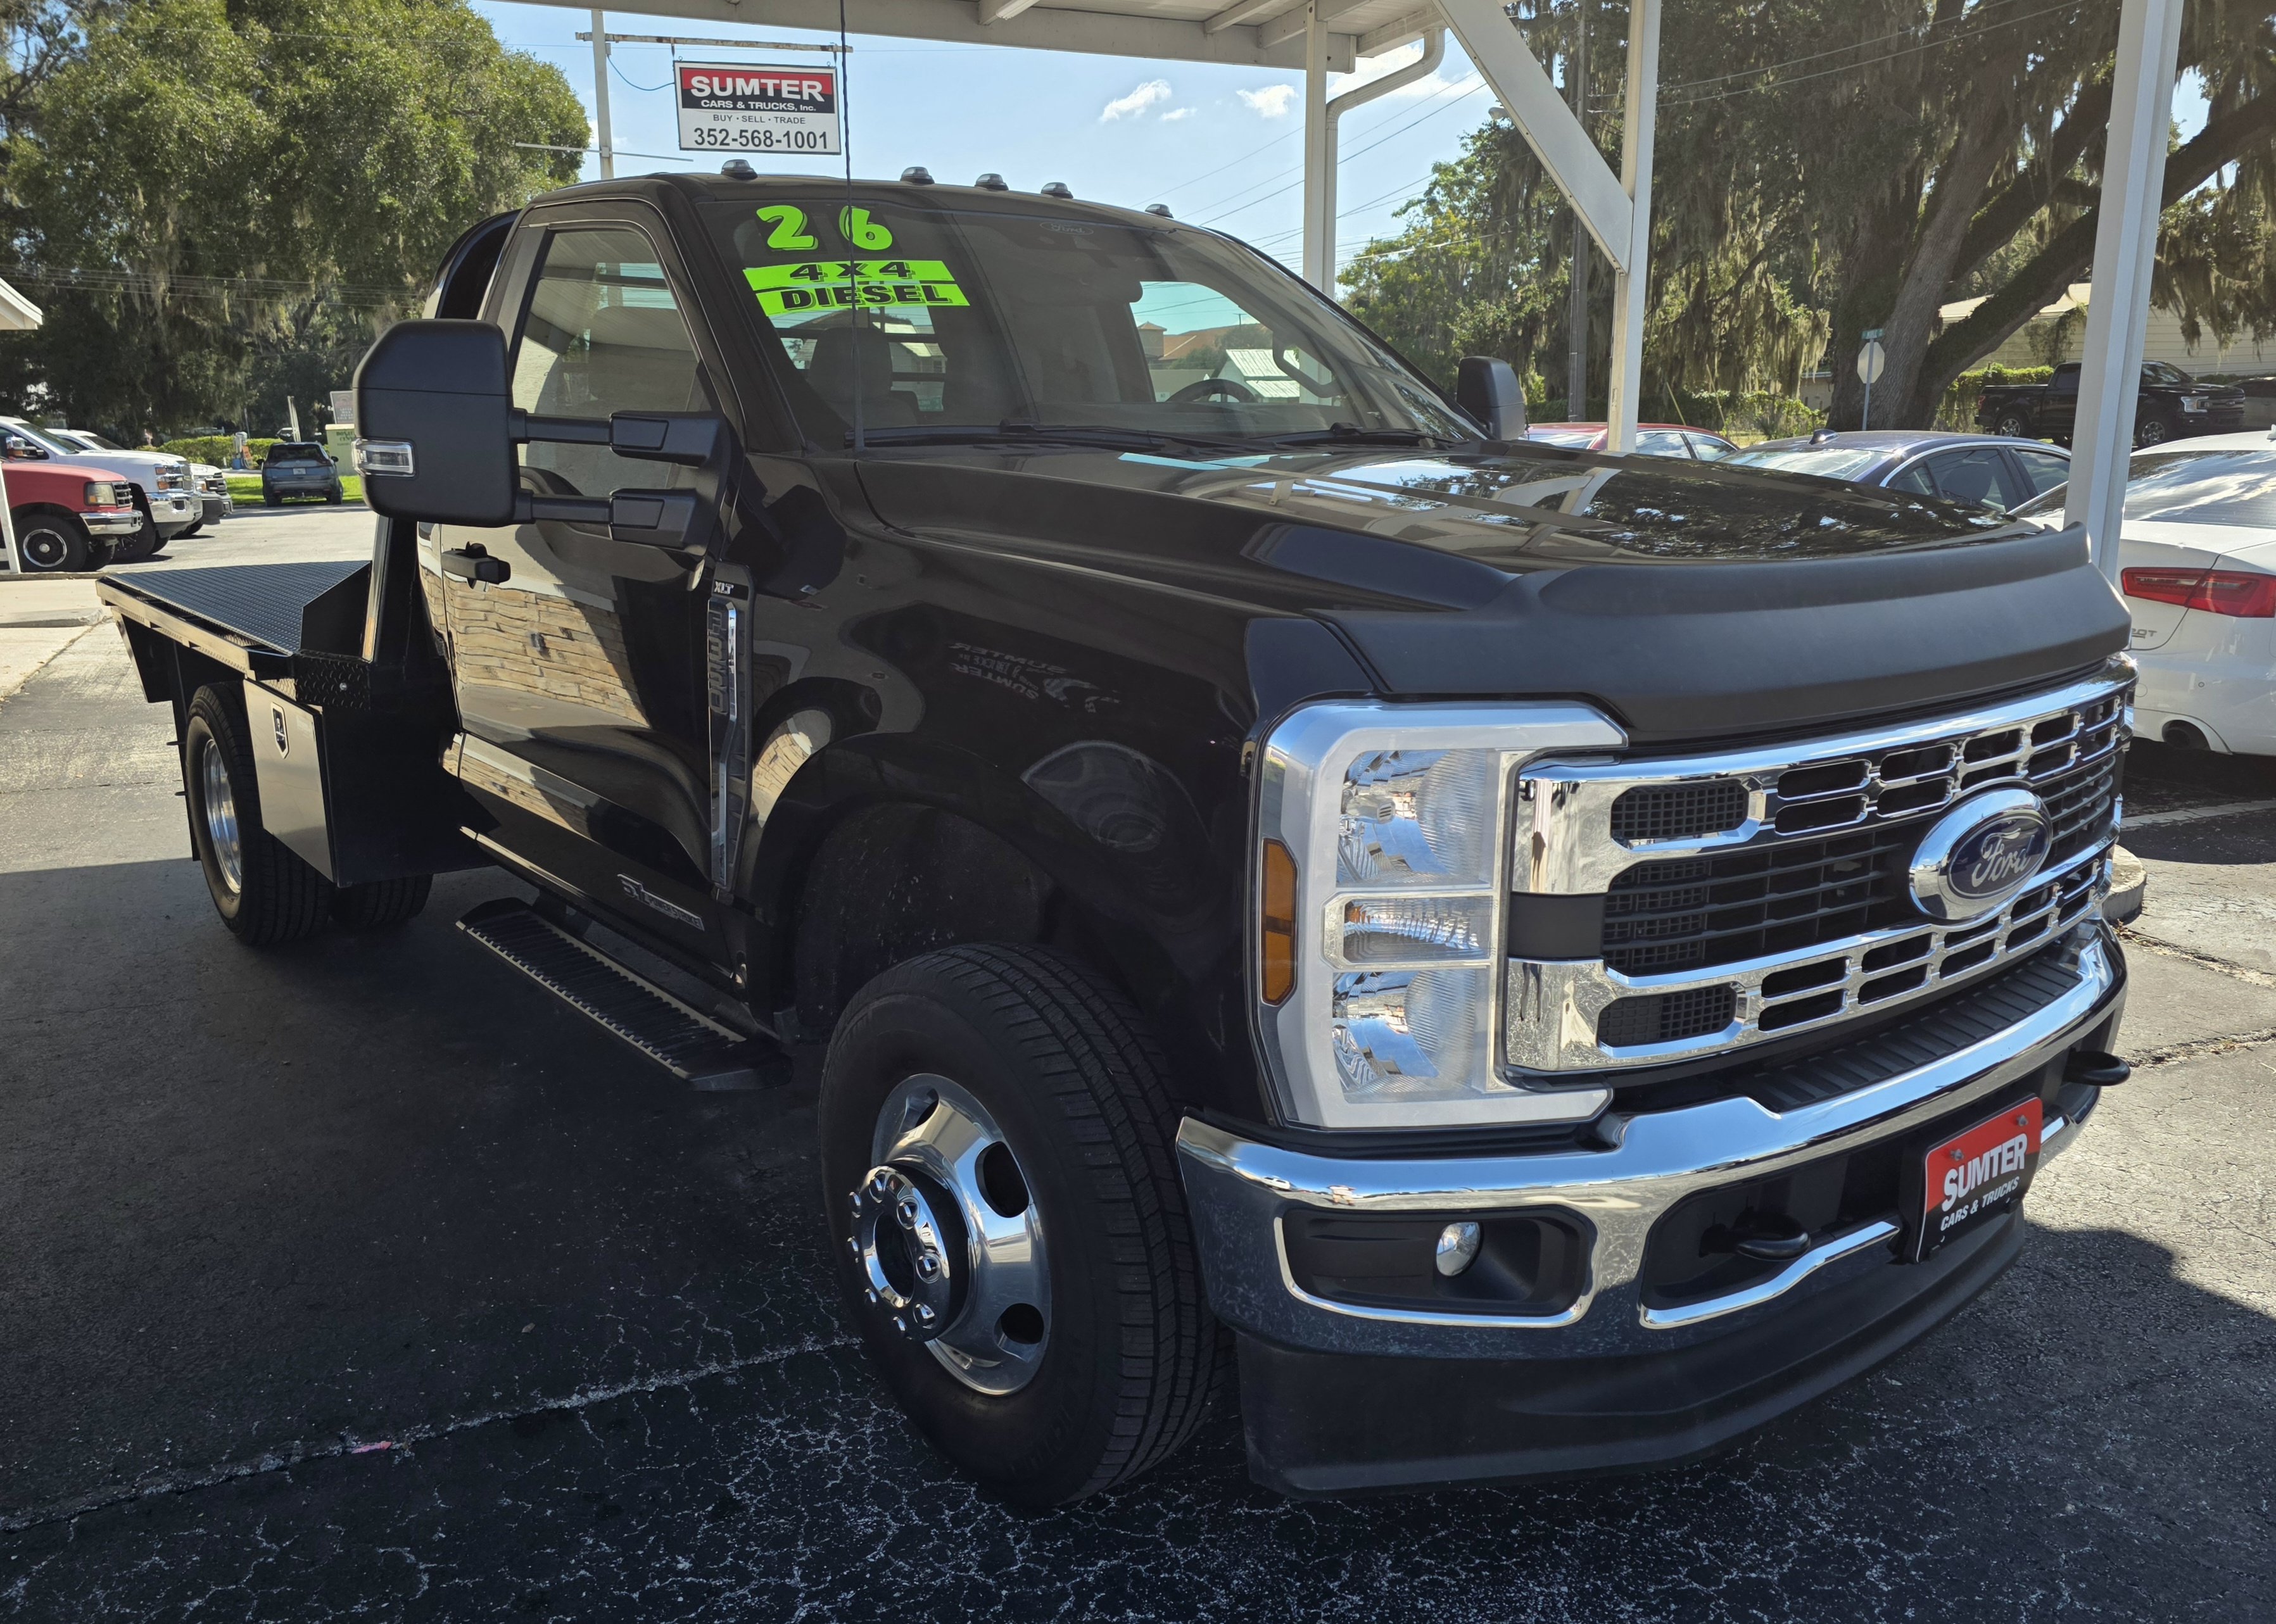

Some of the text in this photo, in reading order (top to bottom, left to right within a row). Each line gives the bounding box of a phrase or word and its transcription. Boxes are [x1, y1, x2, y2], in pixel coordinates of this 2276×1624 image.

[690, 76, 825, 102] SUMTER
[700, 99, 733, 109] CARS
[737, 101, 745, 109] &
[748, 101, 798, 111] TRUCKS,
[694, 127, 827, 149] 352-568-1001
[780, 285, 954, 310] DIESEL
[714, 581, 734, 595] XLT
[1971, 828, 2035, 888] Ford
[1941, 1133, 2028, 1212] SUMTER
[1940, 1176, 2020, 1231] CARS & TRUCKS
